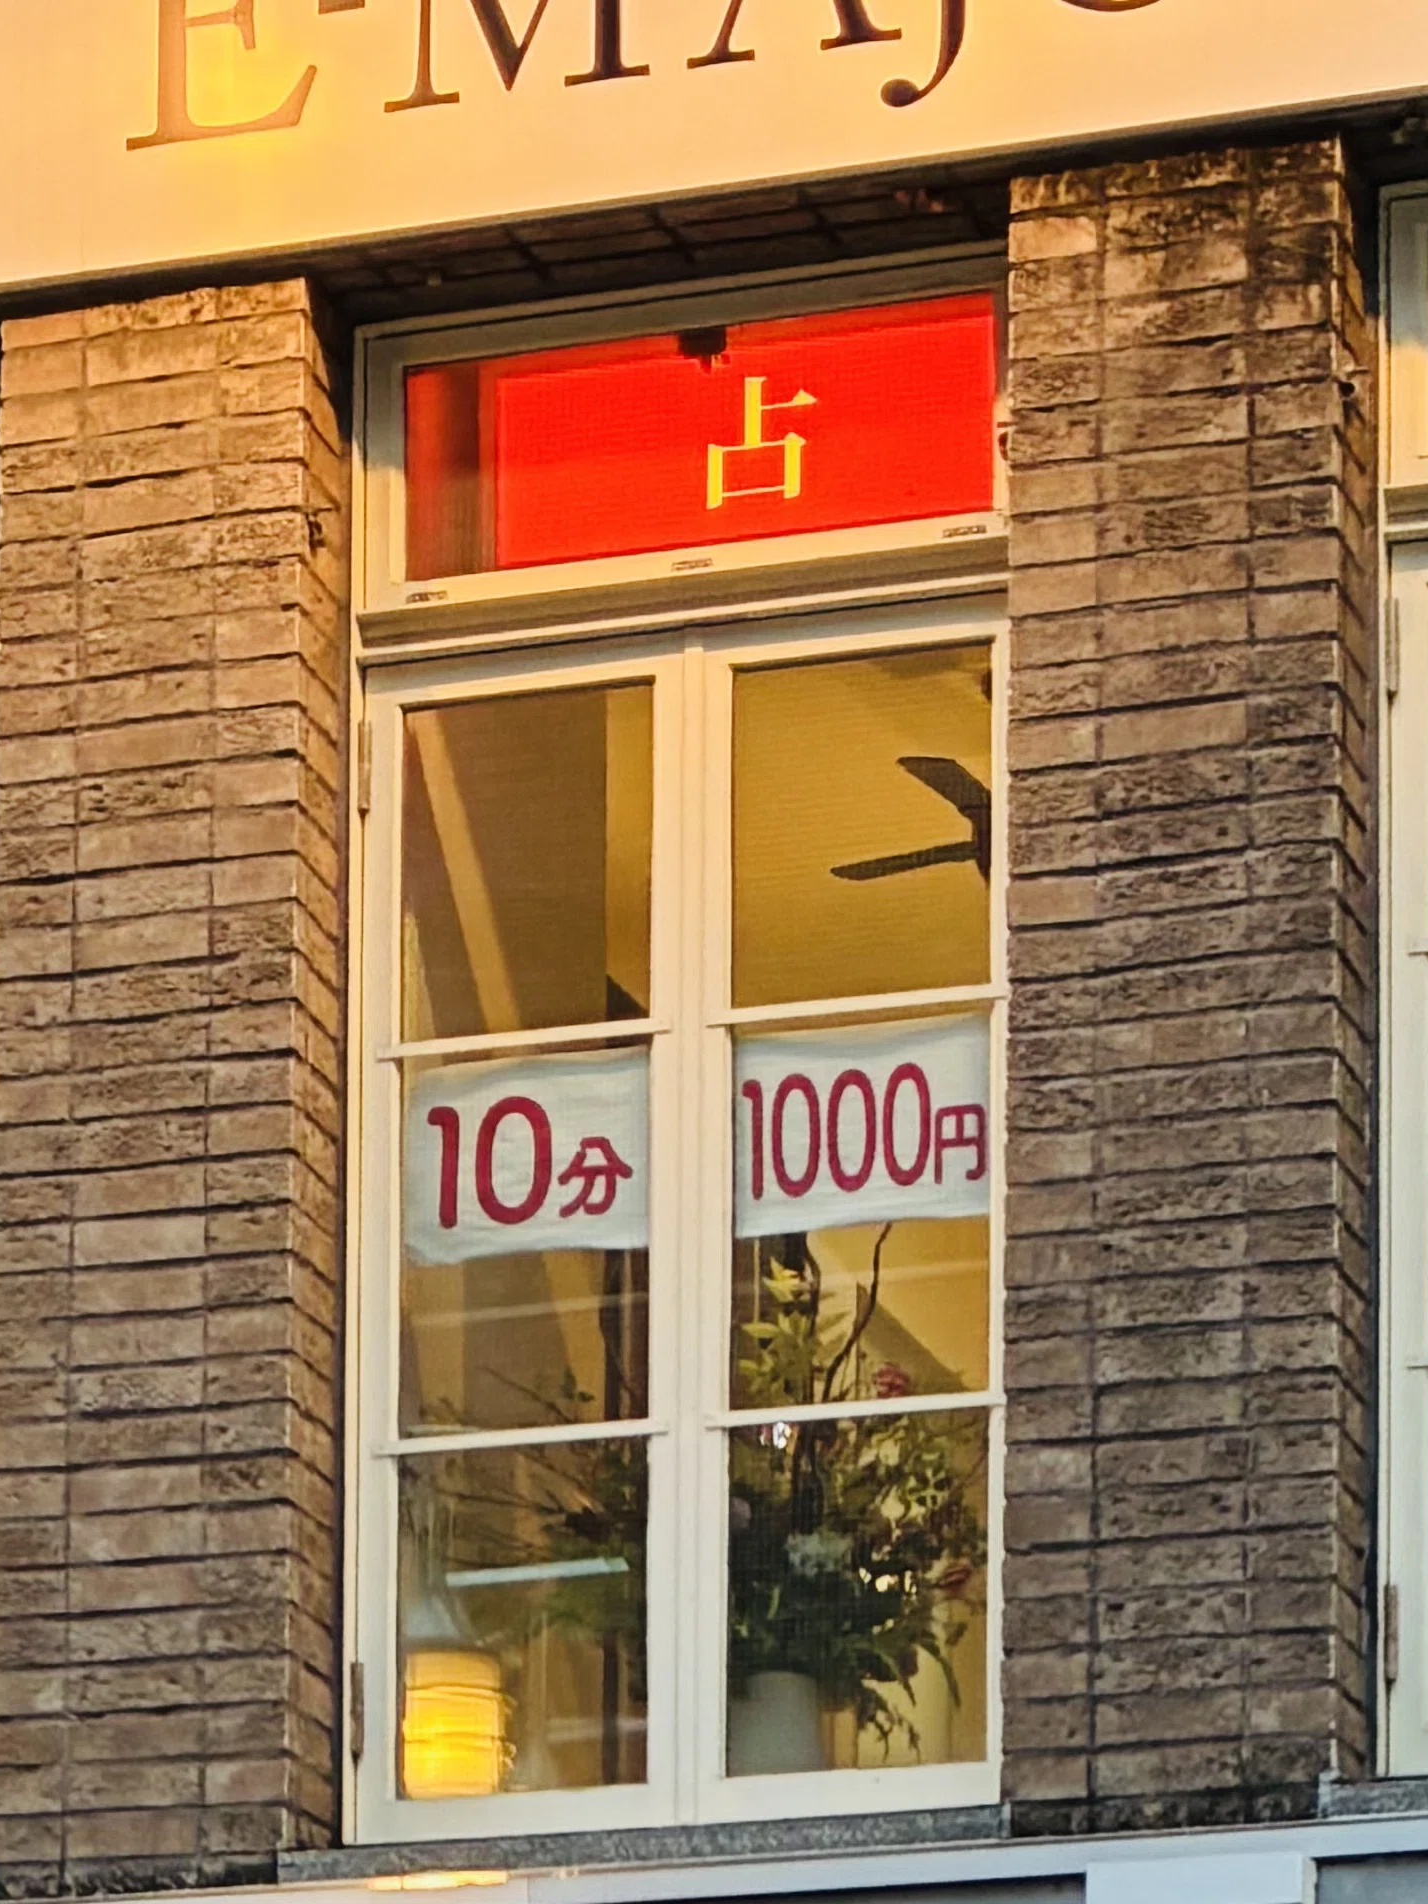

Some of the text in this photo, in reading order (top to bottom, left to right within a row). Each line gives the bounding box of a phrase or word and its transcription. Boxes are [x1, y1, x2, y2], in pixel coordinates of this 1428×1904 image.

[705, 375, 818, 511] 占
[427, 1095, 634, 1230] 10分
[741, 1062, 987, 1201] 1000円
